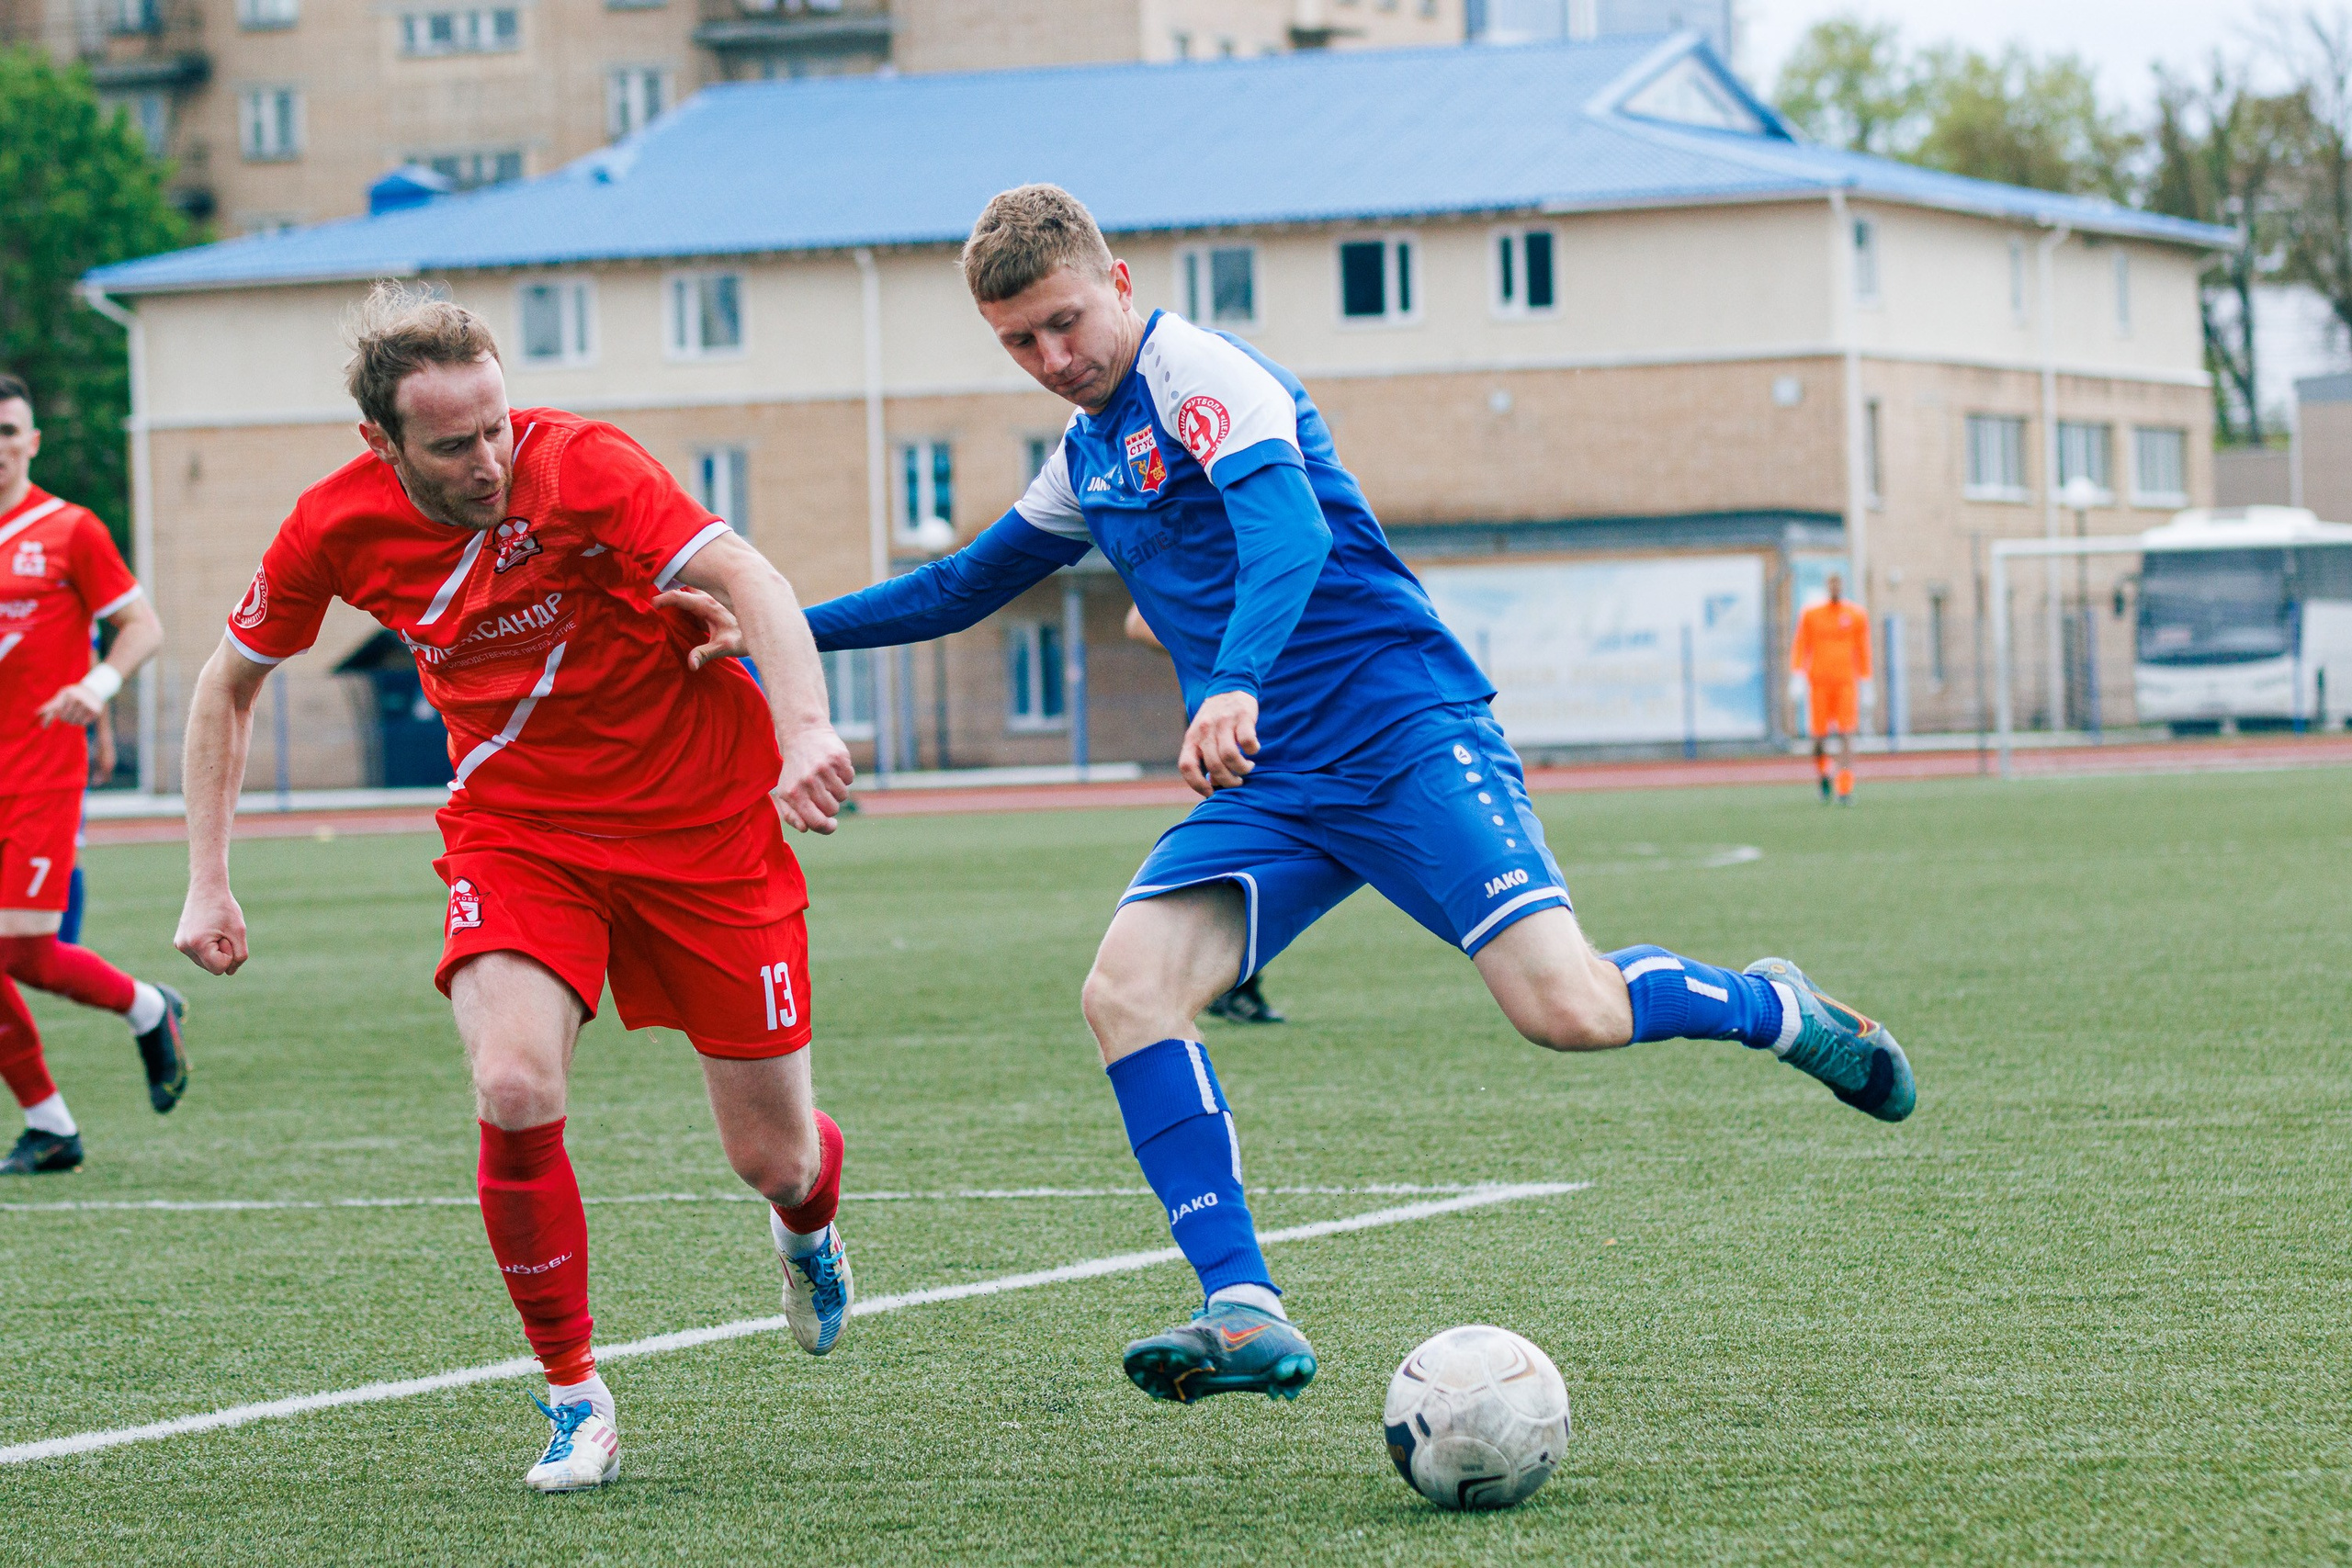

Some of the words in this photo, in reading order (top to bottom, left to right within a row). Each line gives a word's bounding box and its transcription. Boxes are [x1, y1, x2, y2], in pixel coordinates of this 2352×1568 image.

[1185, 398, 1223, 415] ФУТБОЛА
[1130, 436, 1154, 456] СГУС
[522, 620, 577, 655] ПРЕДПЯТИЕ
[27, 856, 51, 898] 7
[1484, 868, 1529, 899] JAKO
[760, 961, 797, 1031] 13
[1171, 1191, 1218, 1226] JAKO
